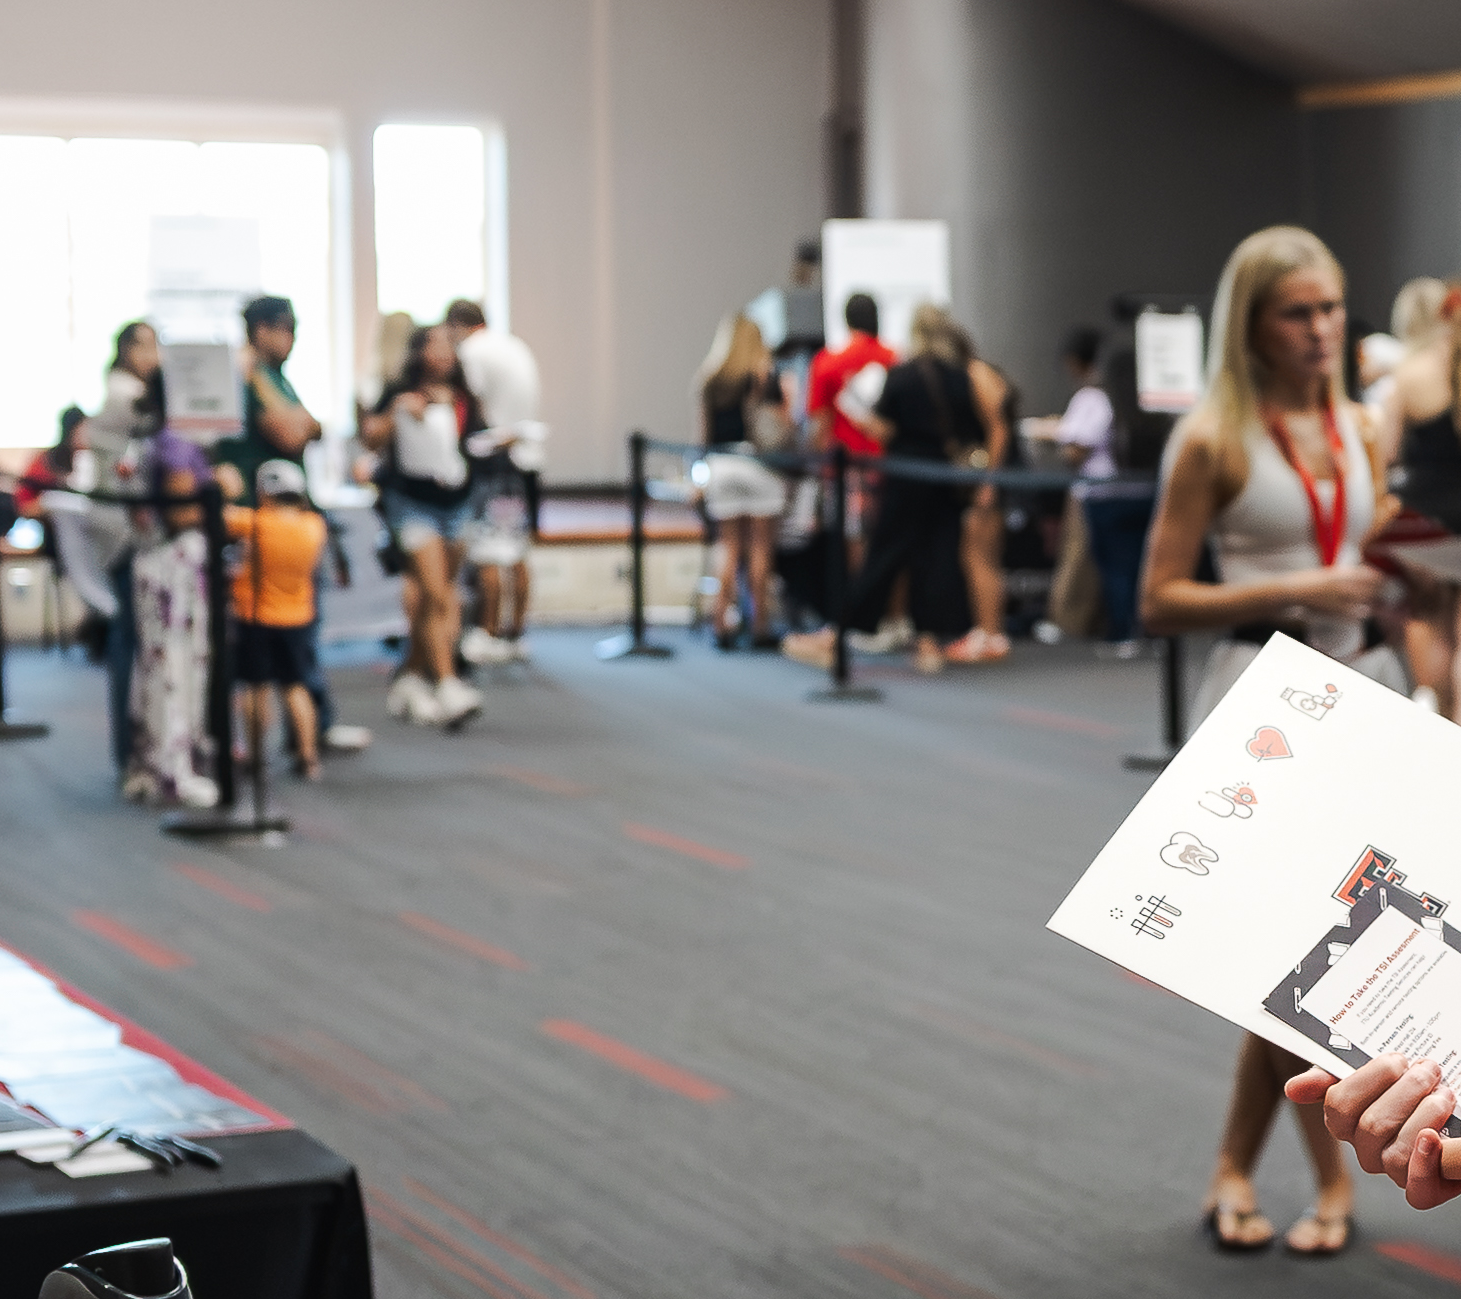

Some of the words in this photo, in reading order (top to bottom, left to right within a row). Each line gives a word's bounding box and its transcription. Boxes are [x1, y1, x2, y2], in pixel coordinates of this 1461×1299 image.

[1374, 960, 1390, 974] TSI
[1365, 973, 1379, 986] the
[1349, 984, 1369, 1001] Take
[1344, 1000, 1355, 1009] to
[1329, 1008, 1347, 1025] How
